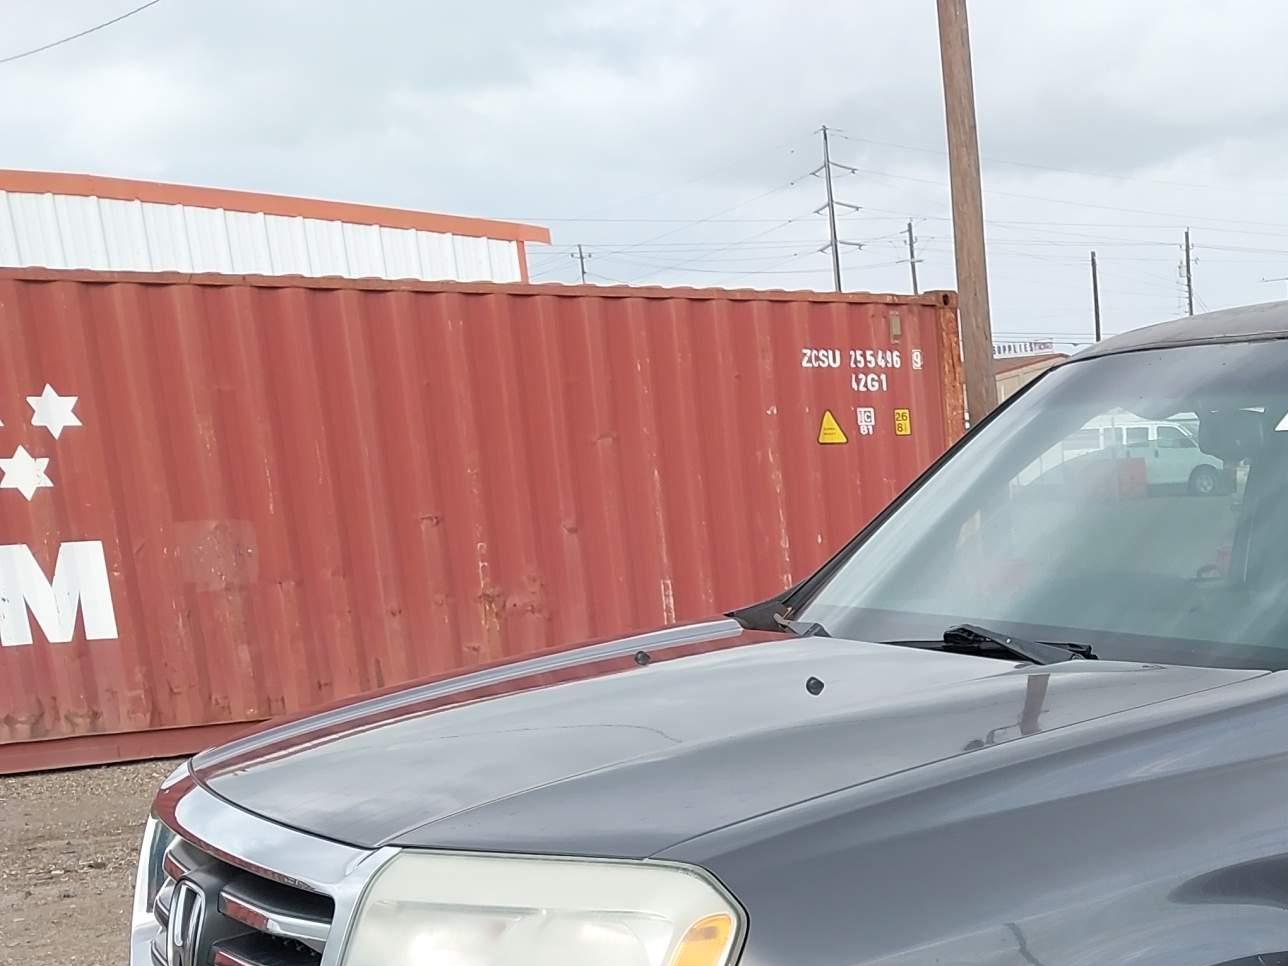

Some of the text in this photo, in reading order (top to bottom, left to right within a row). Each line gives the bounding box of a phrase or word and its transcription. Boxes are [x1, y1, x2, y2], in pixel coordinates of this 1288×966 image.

[802, 349, 841, 368] ZCSU
[849, 350, 901, 368] 255496
[851, 373, 887, 391] 42G1
[0, 540, 118, 646] M
